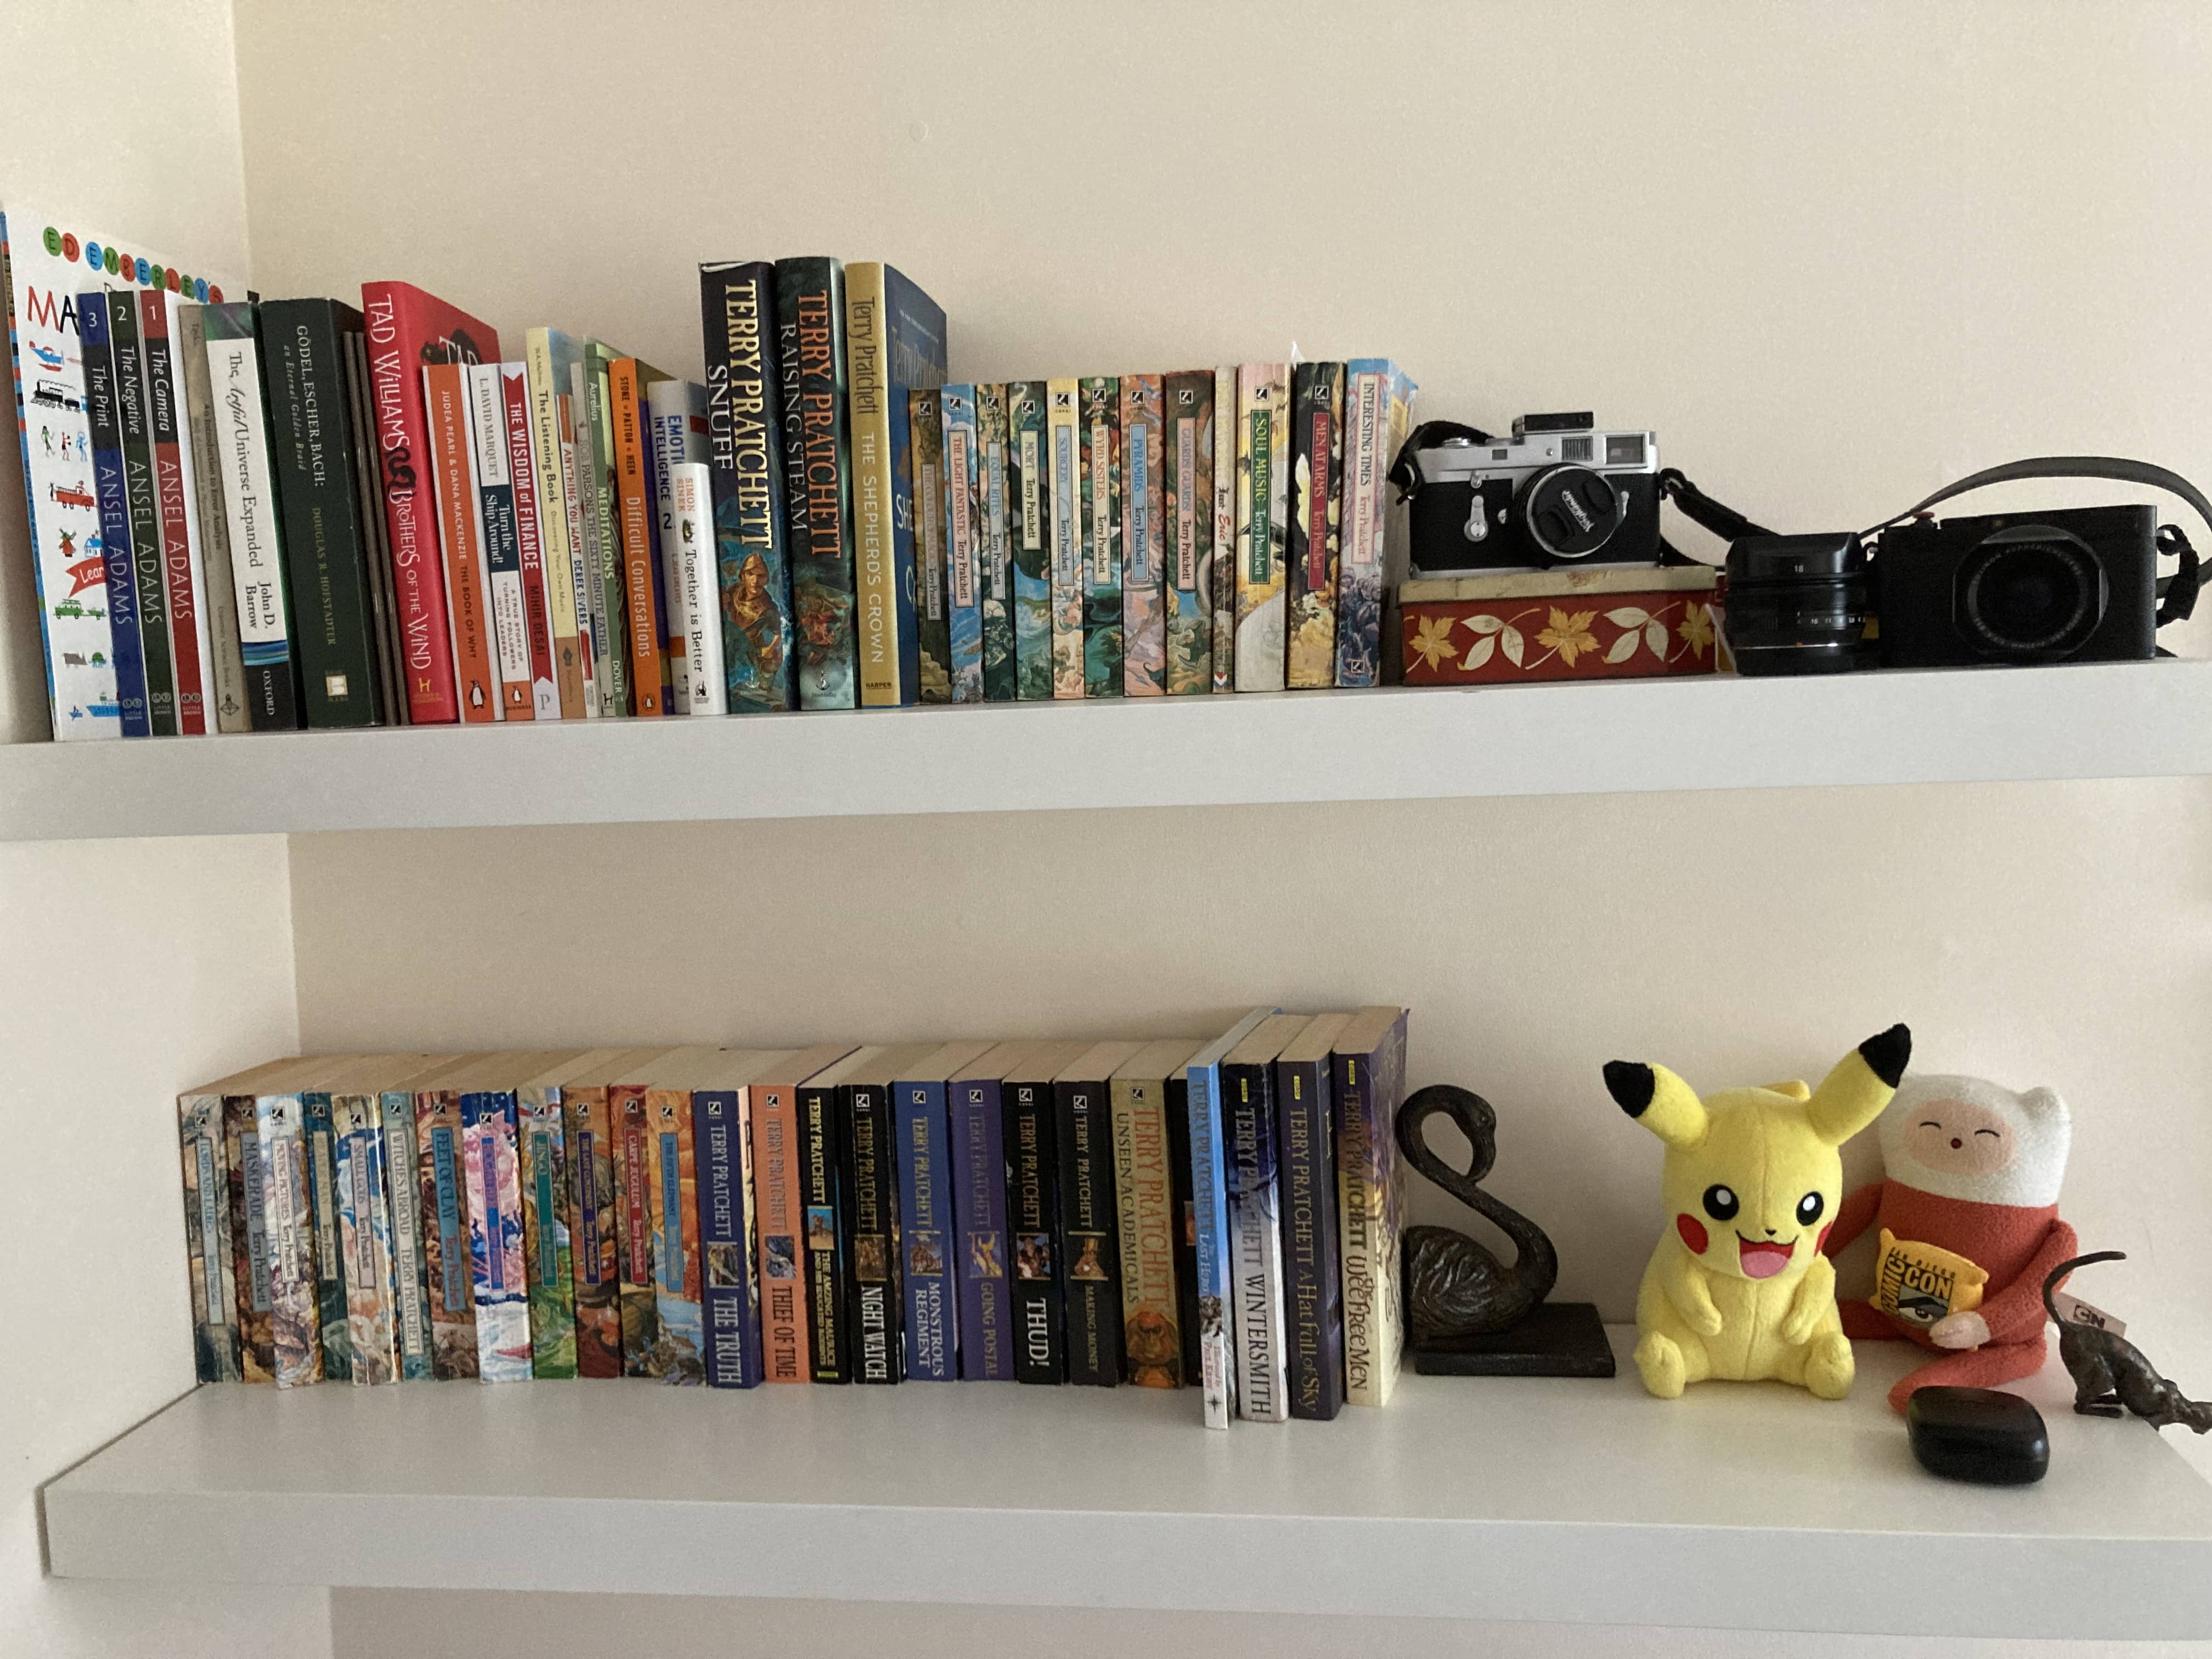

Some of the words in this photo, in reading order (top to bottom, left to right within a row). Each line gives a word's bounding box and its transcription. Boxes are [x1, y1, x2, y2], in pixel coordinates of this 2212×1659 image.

[46, 230, 77, 256] ED
[89, 313, 97, 327] 3
[117, 307, 127, 321] 2
[149, 306, 155, 320] 1
[369, 294, 395, 343] TAD
[725, 280, 761, 373] TERRY
[849, 297, 875, 341] Terry
[798, 290, 831, 381] TERRY
[92, 365, 106, 391] The
[121, 347, 135, 371] The
[152, 350, 166, 374] The
[229, 352, 242, 378] The
[781, 323, 802, 433] RAISING
[620, 377, 630, 401] STONE
[855, 345, 883, 415] Pratchett
[95, 395, 110, 427] Print
[122, 376, 140, 434] Negative
[155, 379, 170, 431] Camera
[303, 382, 321, 442] ESCHER,
[510, 402, 522, 424] THE
[539, 391, 549, 413] The
[589, 382, 601, 421] Aurelius
[708, 364, 733, 469] SNUFF
[1361, 382, 1374, 452] INTERESTING
[542, 417, 554, 471] Listening
[623, 413, 634, 443] PATTON
[953, 438, 962, 455] THE
[1096, 430, 1105, 459] WYRD
[1182, 428, 1192, 468] GUARDS!
[1255, 418, 1267, 455] SOUL
[1316, 421, 1325, 448] MEN
[235, 427, 251, 490] Universe
[311, 443, 325, 487] BACH:
[512, 428, 531, 489] WISDOM
[627, 455, 636, 475] HEEN
[731, 379, 772, 548] PRATCHETT
[861, 433, 875, 465] THE
[1025, 442, 1035, 469] MORT
[1059, 438, 1068, 483] SOURCERY
[1133, 439, 1143, 492] PYRAMIDS
[1316, 450, 1325, 467] AT
[546, 474, 556, 503] Book
[564, 449, 575, 501] ANYTHING
[786, 442, 807, 531] STEAM
[803, 393, 841, 558] PRATCHETT
[955, 458, 964, 483] LIGHT
[990, 456, 1000, 487] EQUAL
[1096, 461, 1106, 500] SISTERS
[1255, 458, 1267, 501] MUSIC
[1315, 469, 1325, 498] ARMS
[1361, 455, 1372, 486] TIMES
[100, 466, 122, 533] ANSEL
[129, 461, 152, 529] ANSEL
[160, 461, 183, 527] ANSEL
[486, 495, 500, 520] Ship
[520, 494, 532, 503] of
[685, 478, 695, 511] SIMON
[955, 488, 967, 535] FANTASTIC
[991, 489, 1002, 516] RITES
[1182, 471, 1192, 512] GUARDS!
[240, 496, 263, 567] Expanded
[388, 489, 420, 567] BROTHERS
[499, 504, 512, 531] Turn
[568, 504, 579, 522] YOU
[588, 517, 597, 537] THE
[597, 487, 614, 579] MEDITATIONS
[627, 498, 644, 554] Difficult
[864, 476, 882, 585] SHEPHERD'S
[1218, 514, 1230, 541] Eric
[490, 521, 503, 563] Around!
[503, 532, 513, 550] the
[519, 507, 538, 569] FINANCE
[571, 528, 582, 555] WANT
[589, 540, 600, 569] SIXTY
[109, 546, 132, 624] ADAMS
[137, 543, 162, 623] ADAMS
[168, 540, 192, 619] ADAMS
[406, 569, 417, 587] OF
[460, 566, 469, 583] THE
[574, 560, 584, 589] DEREK
[592, 573, 603, 614] MINUTE
[685, 550, 699, 611] Together
[245, 585, 258, 629] Barrow
[409, 587, 421, 613] THE
[462, 586, 472, 616] BOOK
[529, 585, 541, 618] MIHIR
[577, 592, 588, 624] SIVERS
[631, 560, 651, 657] Conversations
[691, 615, 702, 625] is
[408, 614, 431, 669] WIND
[466, 619, 474, 633] OF
[507, 622, 516, 670] FOLLOWERS
[533, 623, 545, 655] DESAI
[596, 617, 608, 656] FATHER
[868, 594, 884, 663] CROWN
[469, 636, 477, 659] WHY
[692, 631, 703, 672] Better
[263, 670, 275, 715] OXFORD
[612, 661, 622, 693] DOVER
[809, 1097, 822, 1136] TERRY
[1020, 1114, 1037, 1152] TERRY
[1235, 1108, 1257, 1161] TERRY
[1290, 1108, 1310, 1161] TERRY
[392, 1133, 407, 1187] WITCHES
[437, 1133, 451, 1165] FEET
[710, 1124, 727, 1164] TERRY
[1117, 1113, 1132, 1178] UNSEEN
[245, 1142, 262, 1221] MASKERADE
[440, 1167, 452, 1183] OF
[810, 1136, 825, 1203] PRATCHETT
[442, 1186, 455, 1220] CLAY
[713, 1165, 731, 1238] PRATCHETT
[1022, 1155, 1040, 1228] PRATCHETT
[396, 1190, 410, 1235] ABROAD
[1237, 1166, 1263, 1267] PRATCHETT
[1293, 1165, 1314, 1266] PRATCHETT
[1120, 1186, 1140, 1304] ACADEMICALS
[1199, 1233, 1210, 1261] LAST
[1200, 1262, 1210, 1293] HERO
[1300, 1270, 1309, 1280] A
[1881, 1256, 1905, 1317] COMIC
[1904, 1266, 1953, 1300] CON
[713, 1297, 738, 1327] THE
[773, 1286, 793, 1322] THIEF
[861, 1285, 884, 1329] NIGHT
[981, 1283, 996, 1325] GOING
[1085, 1285, 1095, 1329] MAKING
[1297, 1283, 1317, 1319] Hat
[2073, 1305, 2106, 1330] CN
[774, 1327, 795, 1342] OF
[915, 1289, 930, 1368] REGIMENT
[928, 1282, 944, 1377] MONSTROUS
[1026, 1298, 1050, 1367] THUD!
[1245, 1273, 1271, 1414] WINTERSMITH
[715, 1332, 742, 1384] TRUTH
[776, 1346, 796, 1377] TIME
[865, 1331, 887, 1379] WATCH
[984, 1329, 998, 1376] POSTAL
[1088, 1332, 1098, 1372] MONEY
[1302, 1358, 1314, 1373] of
